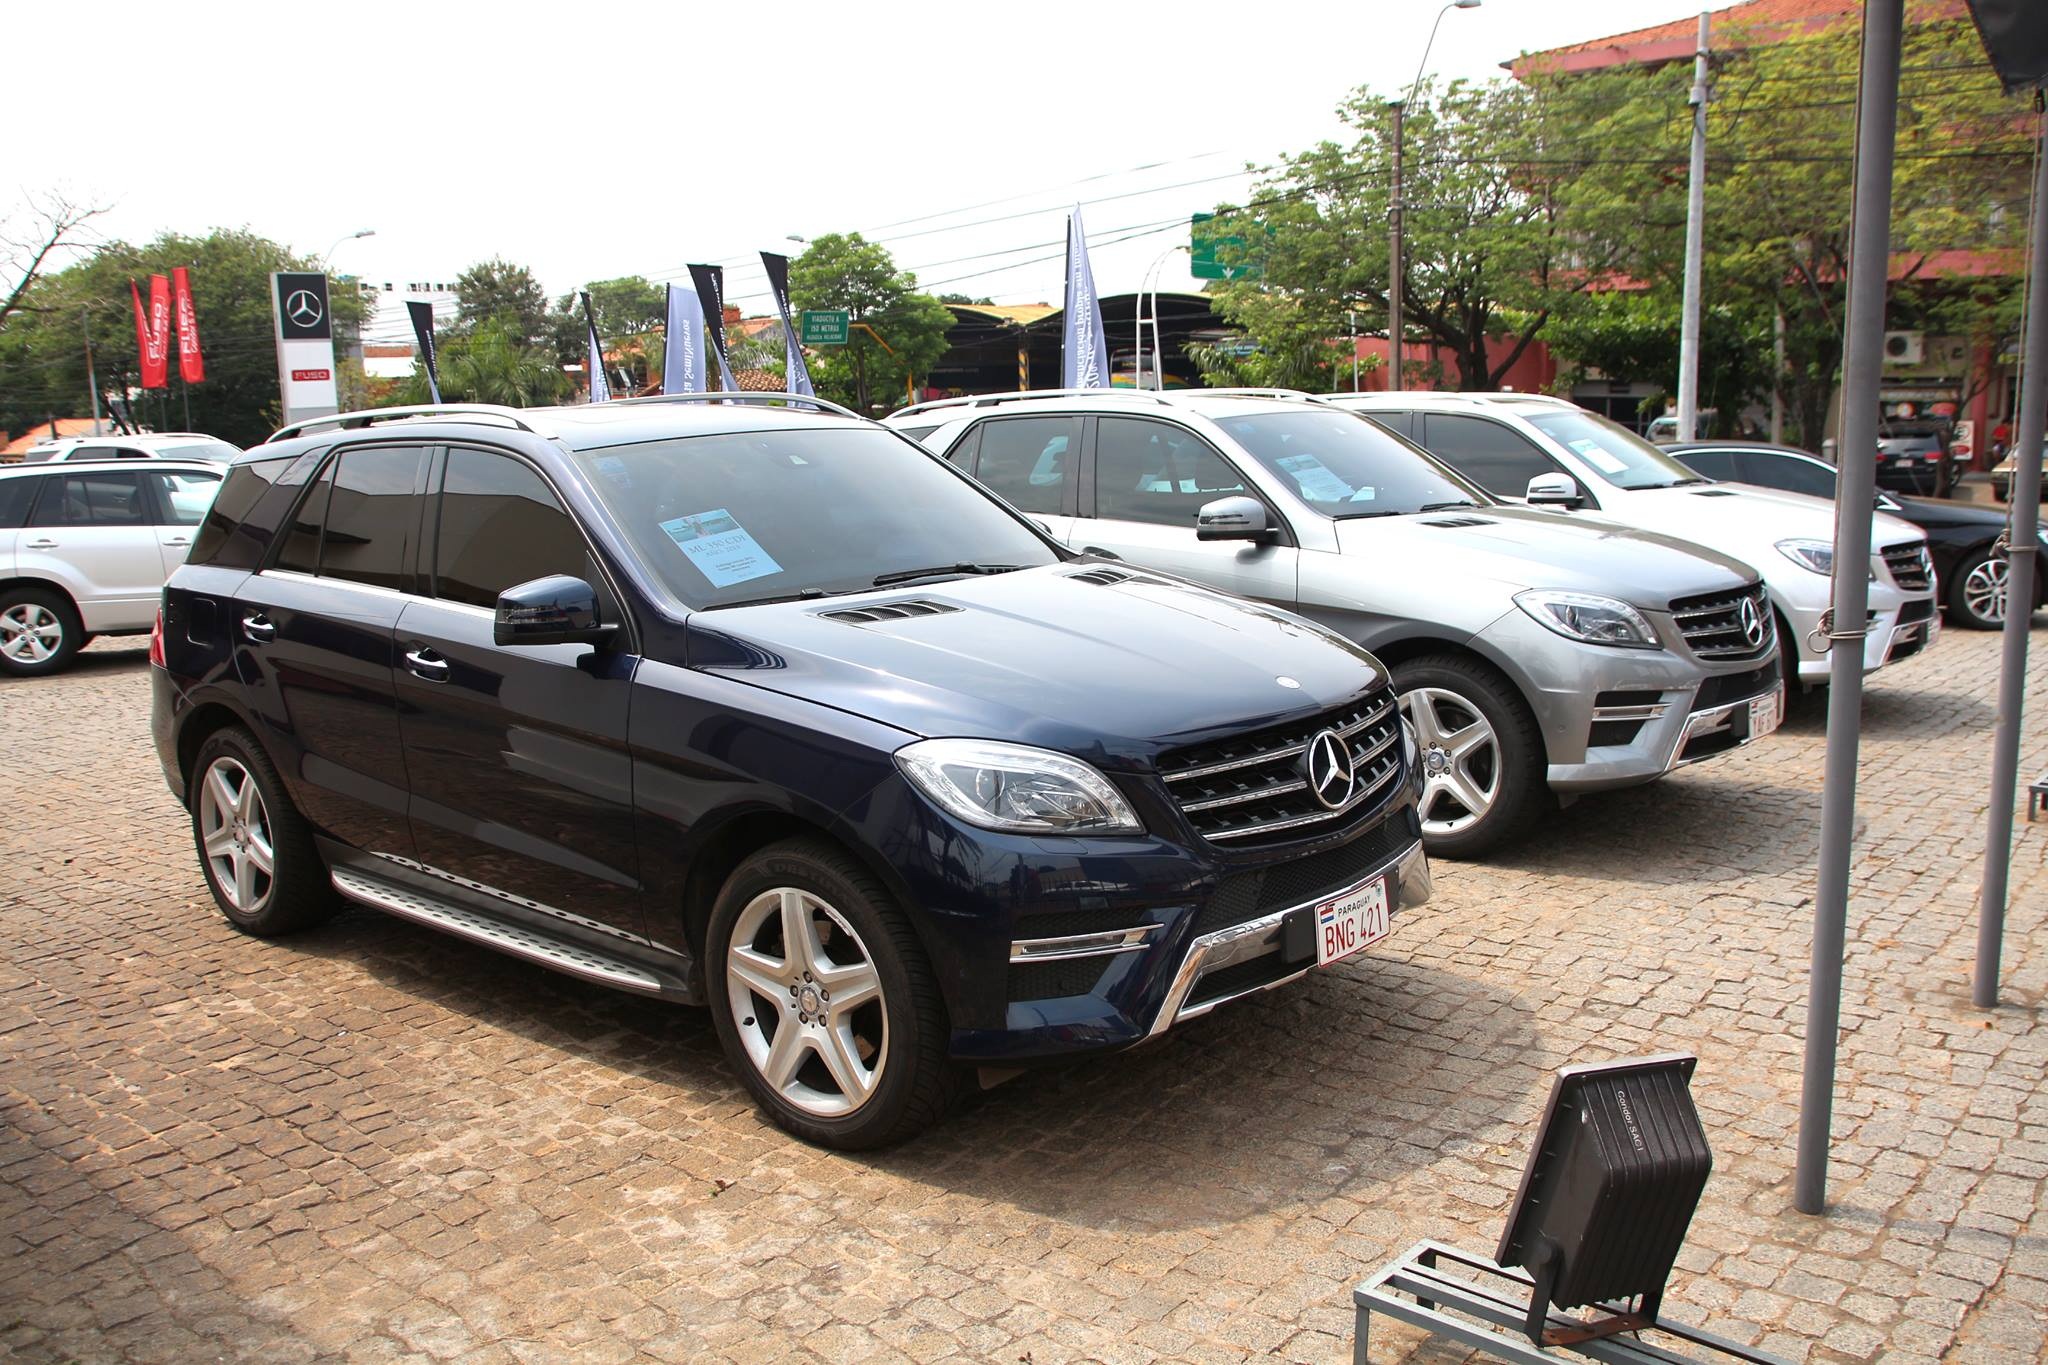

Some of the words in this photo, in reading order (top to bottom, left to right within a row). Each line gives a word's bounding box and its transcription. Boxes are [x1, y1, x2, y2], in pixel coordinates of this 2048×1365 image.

[294, 371, 328, 380] FUSO
[1337, 894, 1371, 918] PARAGUAY
[1325, 917, 1355, 958] BNG
[1360, 902, 1382, 941] 421
[1617, 1090, 1633, 1125] Condor
